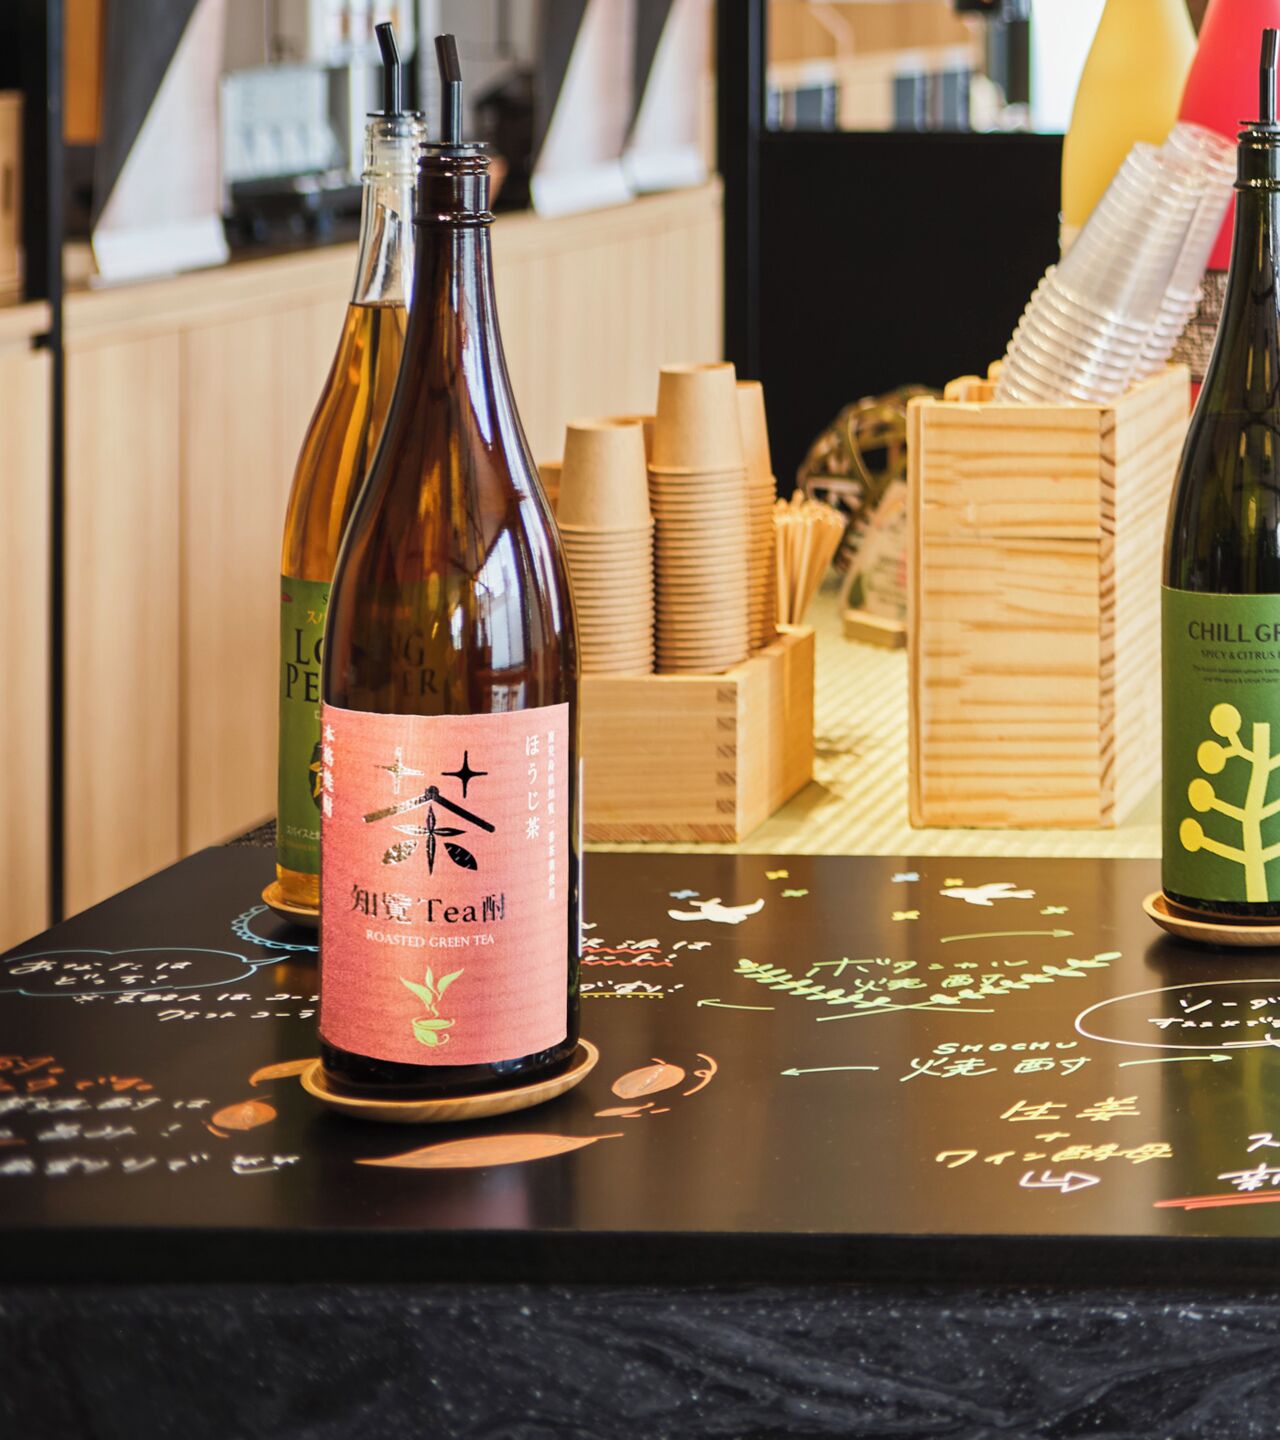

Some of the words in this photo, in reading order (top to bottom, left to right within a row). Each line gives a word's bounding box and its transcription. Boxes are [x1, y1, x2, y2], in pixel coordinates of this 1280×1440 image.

[1188, 620, 1252, 643] CHILL
[525, 734, 540, 841] ほうじ茶
[365, 928, 426, 948] ROASTED
[429, 934, 471, 948] GREEN
[473, 933, 496, 946] TEA
[932, 1041, 1079, 1055] SHOCHU
